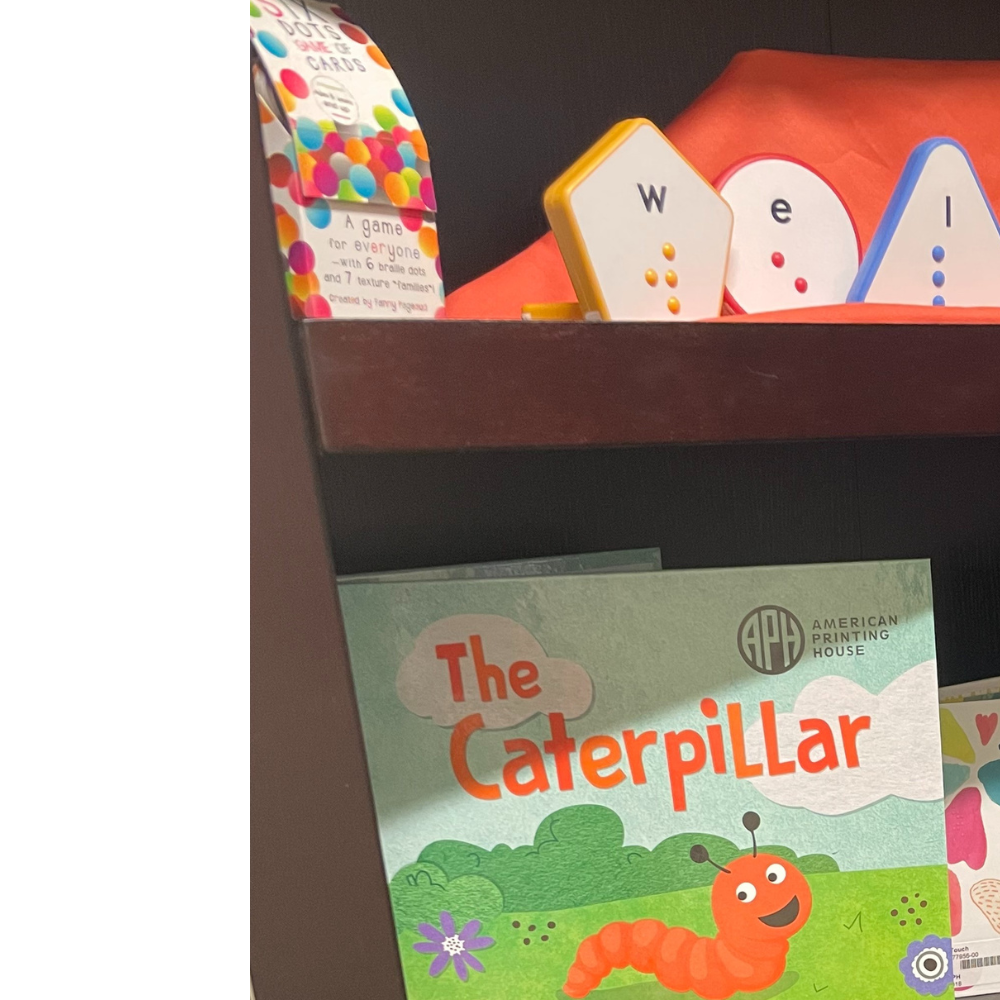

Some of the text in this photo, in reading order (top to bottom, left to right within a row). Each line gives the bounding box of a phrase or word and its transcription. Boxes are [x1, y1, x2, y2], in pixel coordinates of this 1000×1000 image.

[277, 19, 341, 40] DOTS
[306, 55, 366, 72] CARDS
[770, 198, 792, 224] e
[345, 214, 403, 238] A game
[329, 238, 420, 262] for everyone
[366, 257, 374, 270] 6
[379, 262, 405, 275] braille
[408, 266, 427, 277] dots
[324, 273, 341, 284] and
[344, 271, 351, 285] 7
[357, 276, 391, 289] texture
[812, 615, 899, 631] AMERICAN
[812, 629, 890, 644] PRINTING
[813, 645, 865, 658] HOUSE
[435, 634, 542, 703] The
